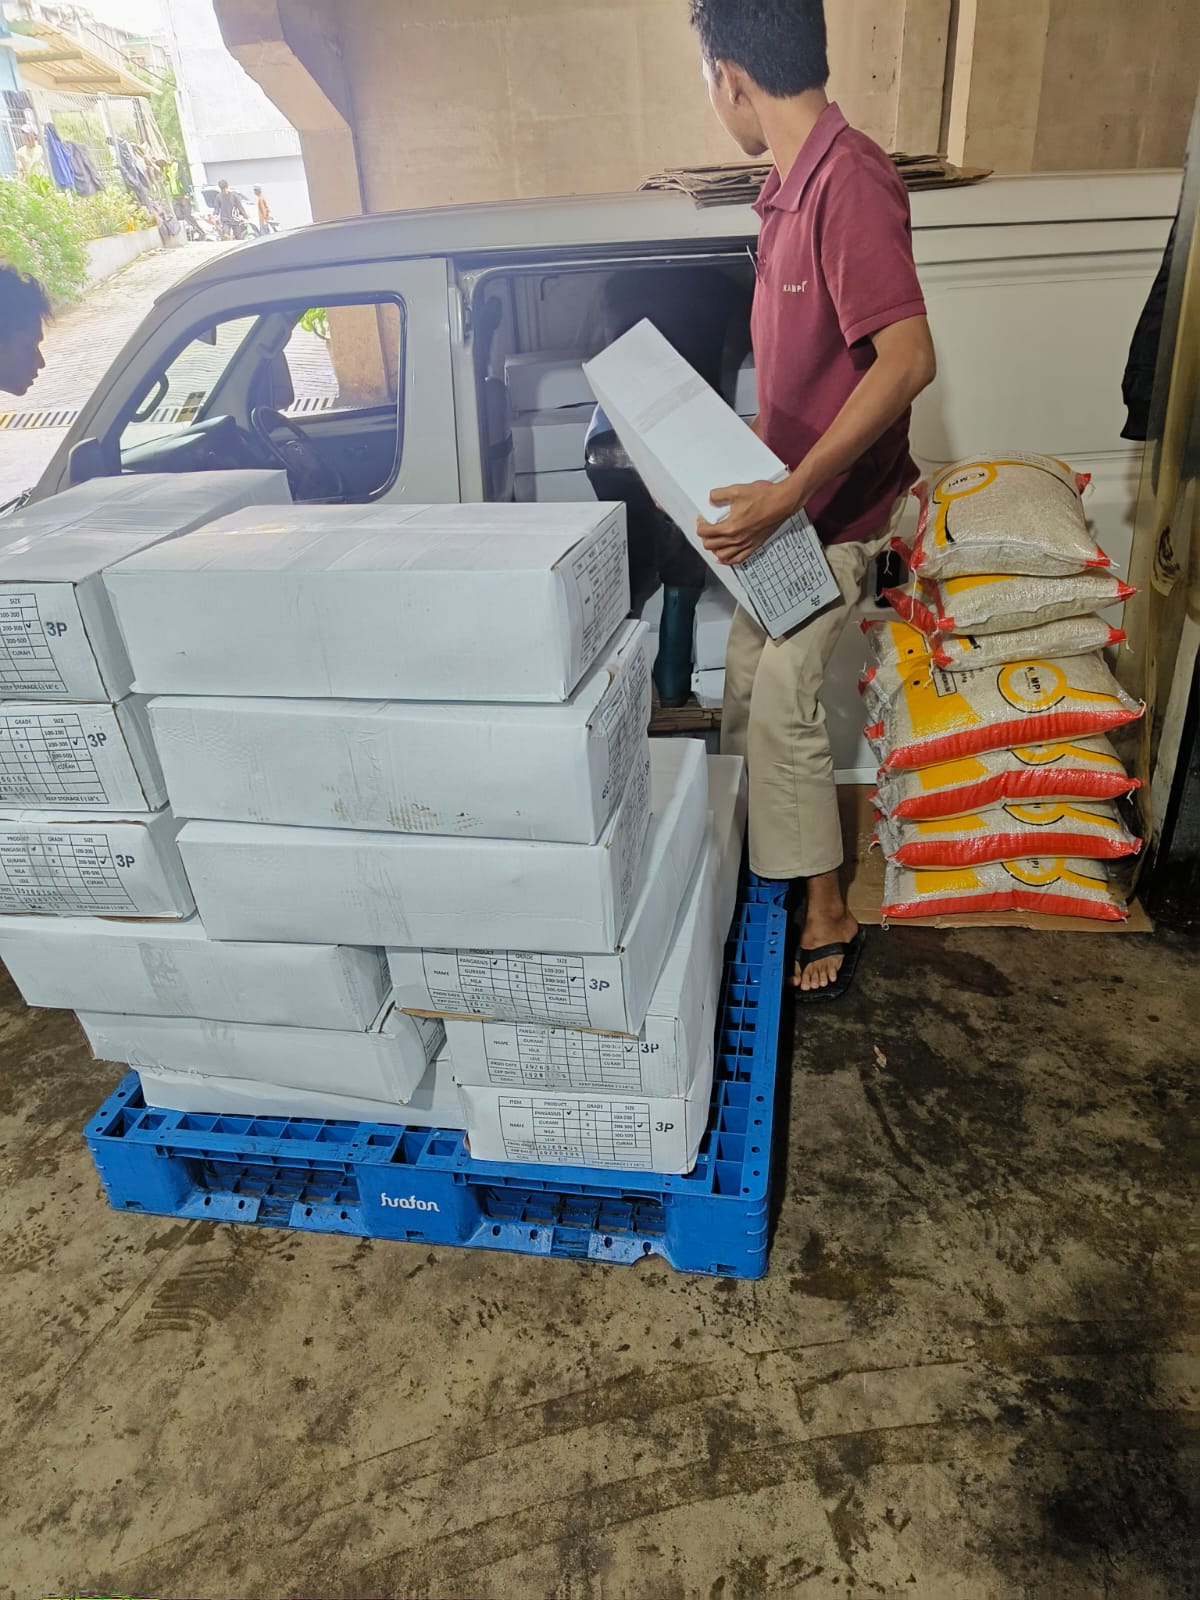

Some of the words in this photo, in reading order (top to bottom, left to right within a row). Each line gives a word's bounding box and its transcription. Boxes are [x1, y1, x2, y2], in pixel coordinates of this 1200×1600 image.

[46, 621, 67, 637] 3P
[87, 732, 107, 747] 3P
[116, 854, 135, 868] 3P
[589, 978, 611, 992] 3P
[641, 1042, 659, 1054] 3P
[655, 1121, 674, 1133] 3P
